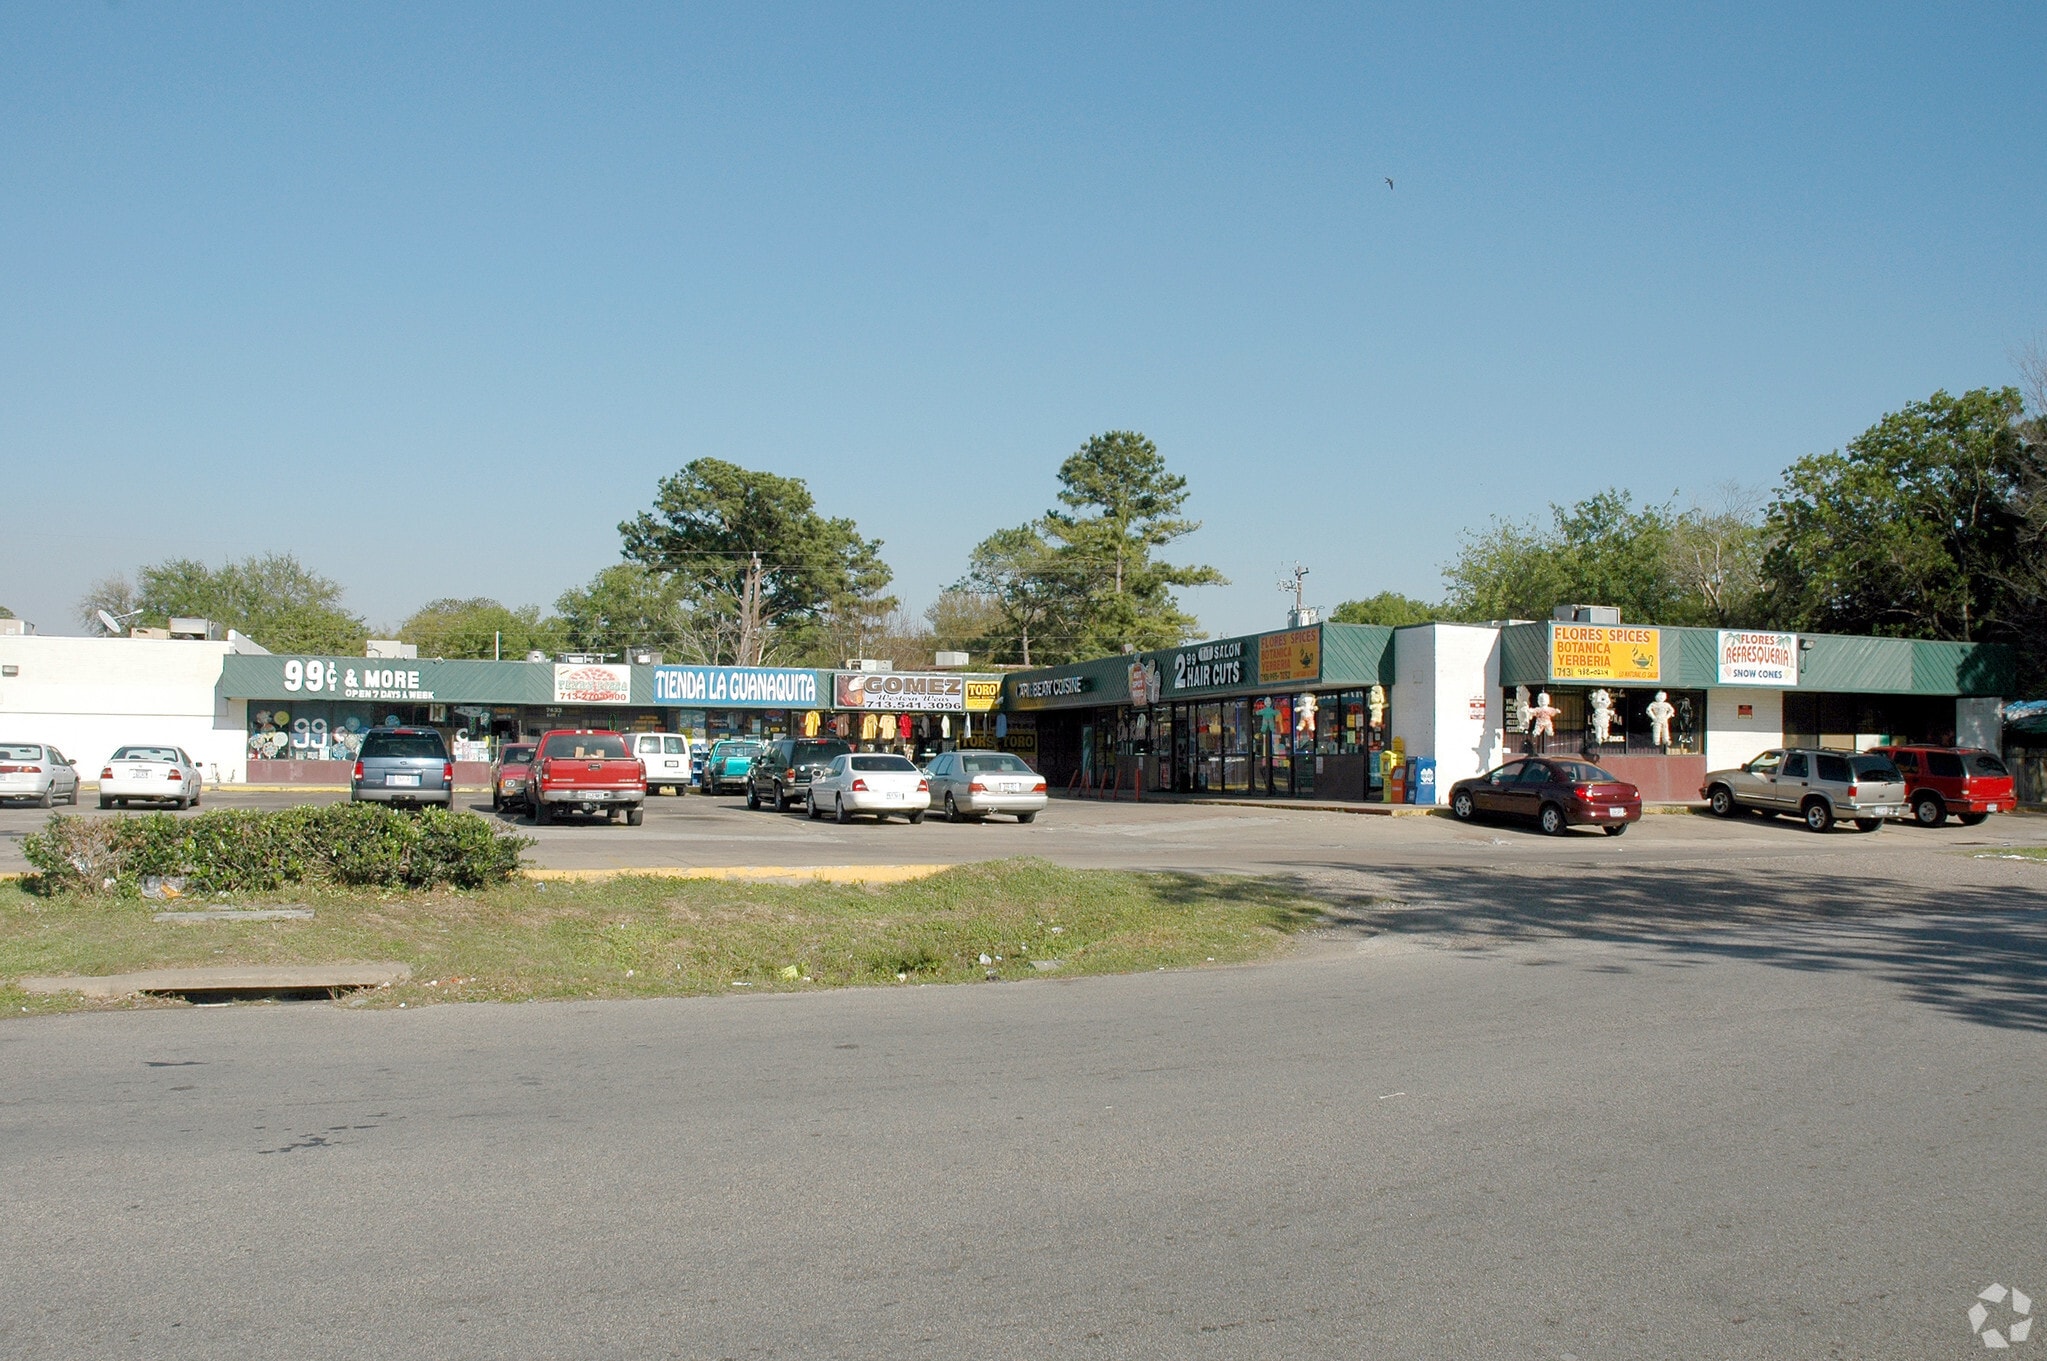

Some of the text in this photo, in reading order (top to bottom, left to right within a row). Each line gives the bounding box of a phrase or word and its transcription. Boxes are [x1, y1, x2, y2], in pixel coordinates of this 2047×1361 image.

[1261, 629, 1316, 649] FLORES SPICES
[1554, 627, 1651, 643] FLORES SPICES
[1741, 634, 1775, 645] FLORES
[1213, 642, 1241, 660] SALON
[1261, 647, 1292, 661] BOTANICA
[1557, 641, 1611, 654] BOTANICA
[1558, 654, 1611, 667] YERBERIA
[1726, 645, 1789, 667] REFRESQUERIA
[344, 668, 420, 689] & MORE
[1174, 653, 1196, 689] 2 99
[1187, 660, 1240, 688] HAIR CUTS
[1733, 669, 1783, 679] SNOW CONES
[655, 670, 816, 702] TIENDA LA GUANAQUITA
[864, 676, 961, 696] GOMEZ
[968, 684, 997, 696] TORO
[345, 689, 371, 698] OPEN
[372, 690, 379, 698] 7
[380, 691, 402, 699] DAYS
[408, 691, 434, 700] WEEK
[876, 694, 918, 702] Western
[866, 700, 961, 710] 713.541.3096
[293, 718, 328, 748] 99
[962, 735, 996, 748] TOR
